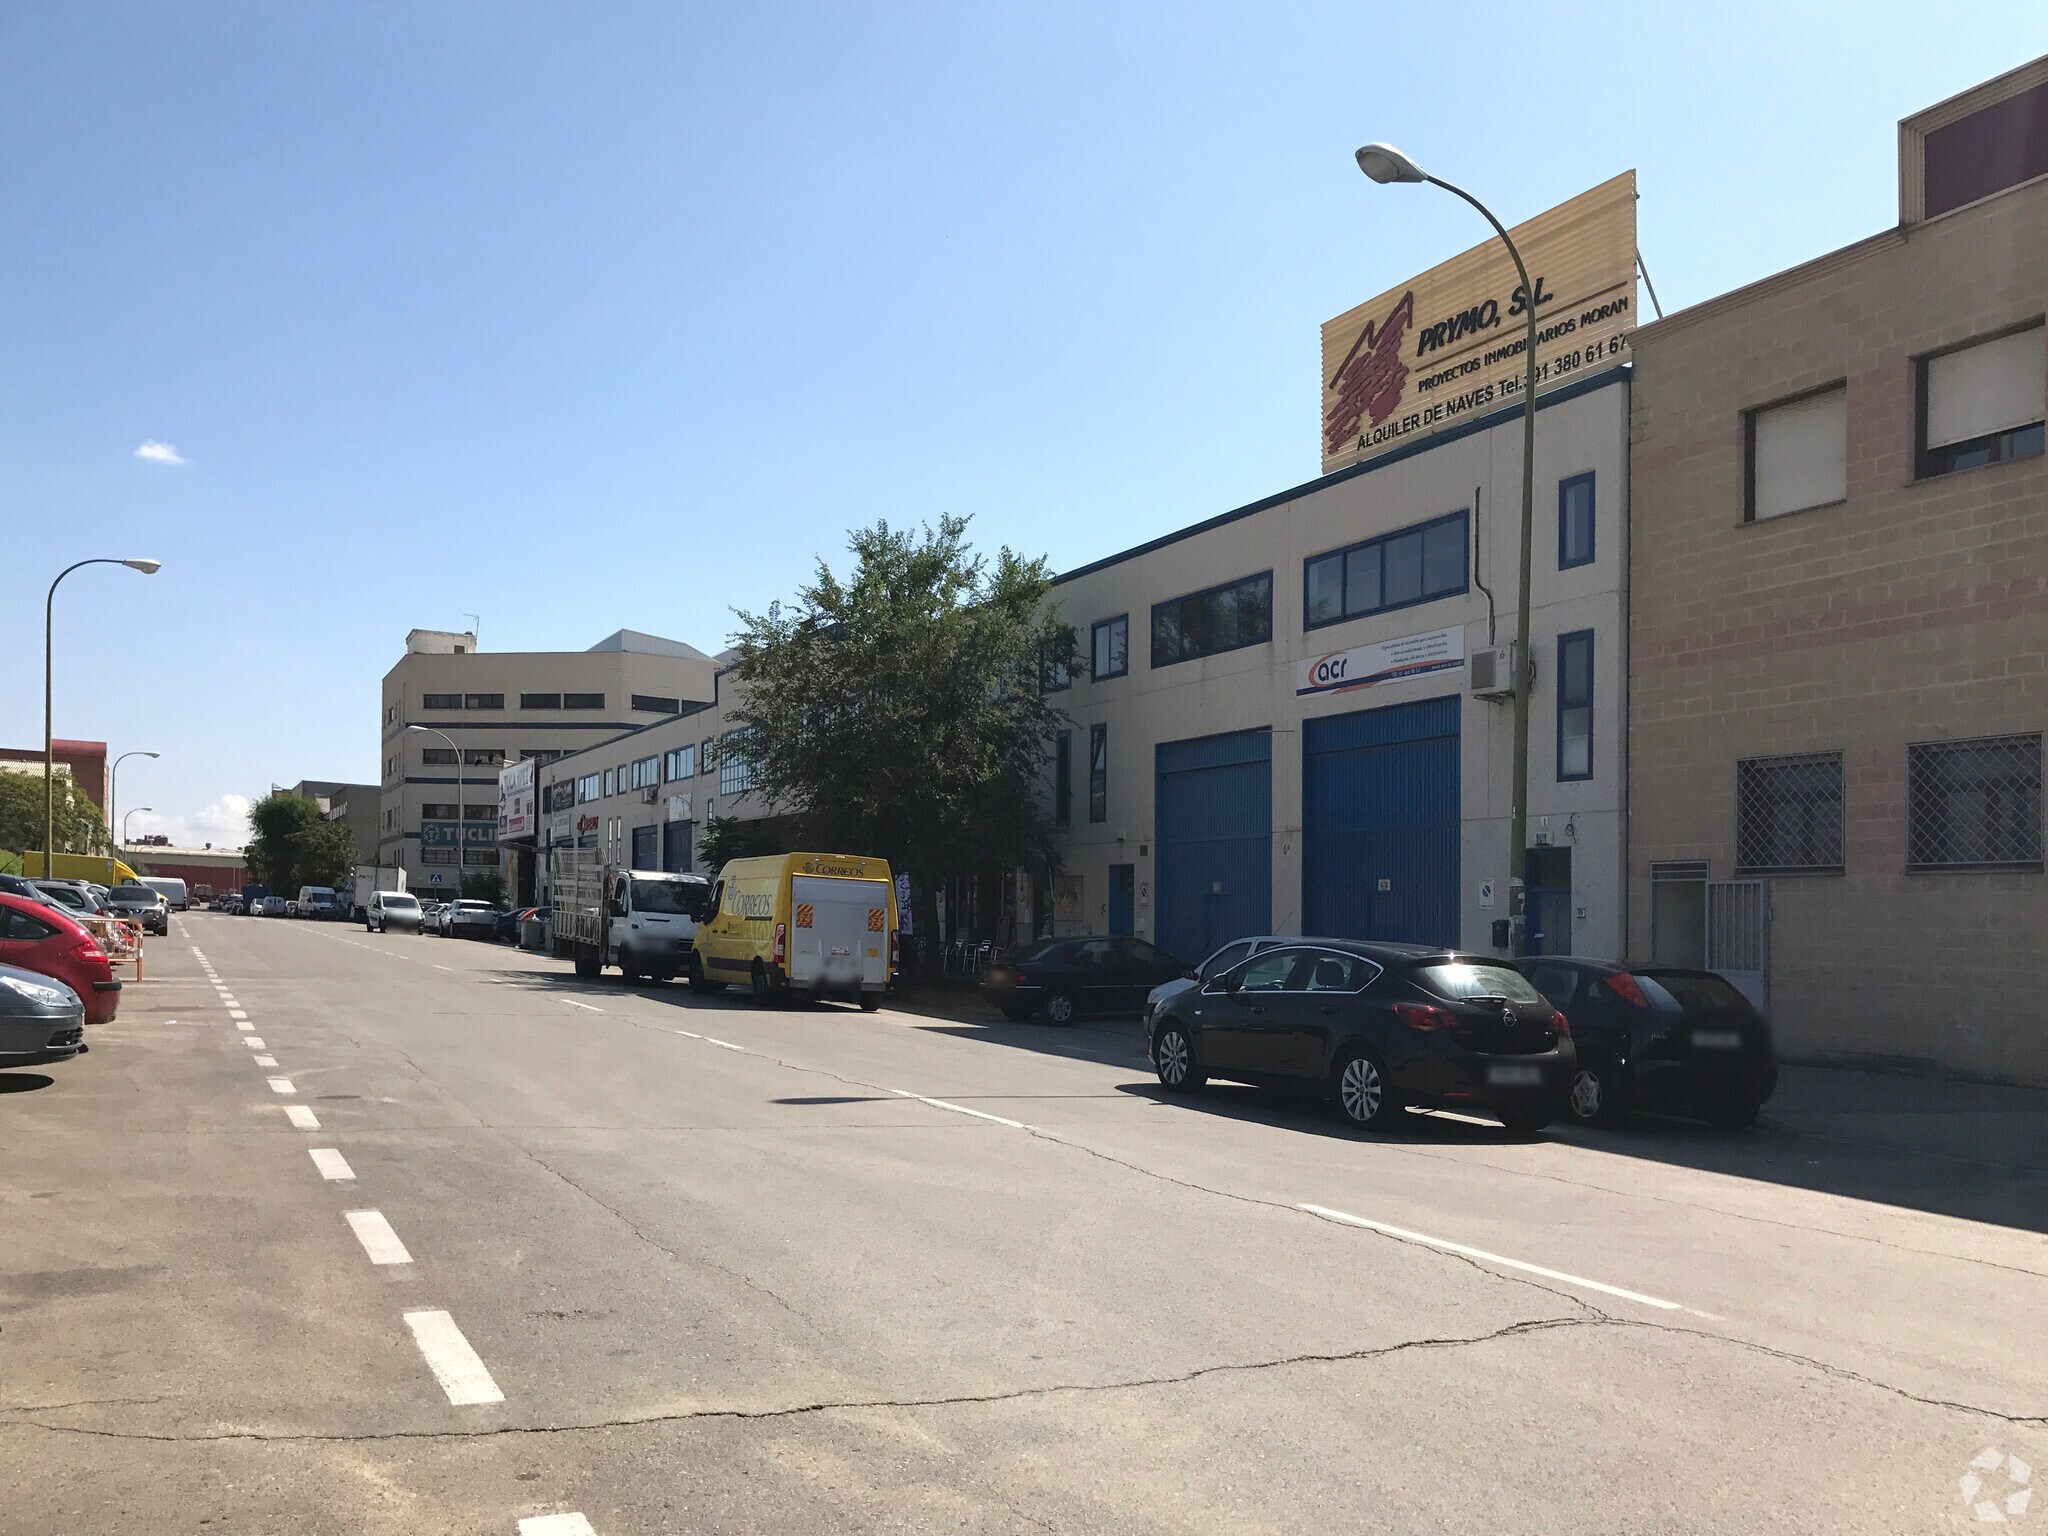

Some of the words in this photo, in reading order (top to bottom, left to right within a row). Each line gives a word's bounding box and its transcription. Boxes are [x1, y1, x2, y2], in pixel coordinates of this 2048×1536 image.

[1416, 299, 1501, 357] PRYMO,
[1508, 276, 1553, 316] SL.
[1418, 357, 1481, 393] PROYECTOS
[1484, 318, 1576, 366] INMOBIARIOS
[1580, 296, 1628, 326] MORAN
[1356, 415, 1420, 451] ALQUILER
[1423, 405, 1443, 426] DE
[1446, 384, 1494, 416] NAVES
[1554, 350, 1581, 376] 380
[1585, 341, 1603, 365] 61
[1318, 658, 1348, 682] acr
[815, 863, 864, 877] CORREOS
[731, 890, 772, 915] CORREOS
